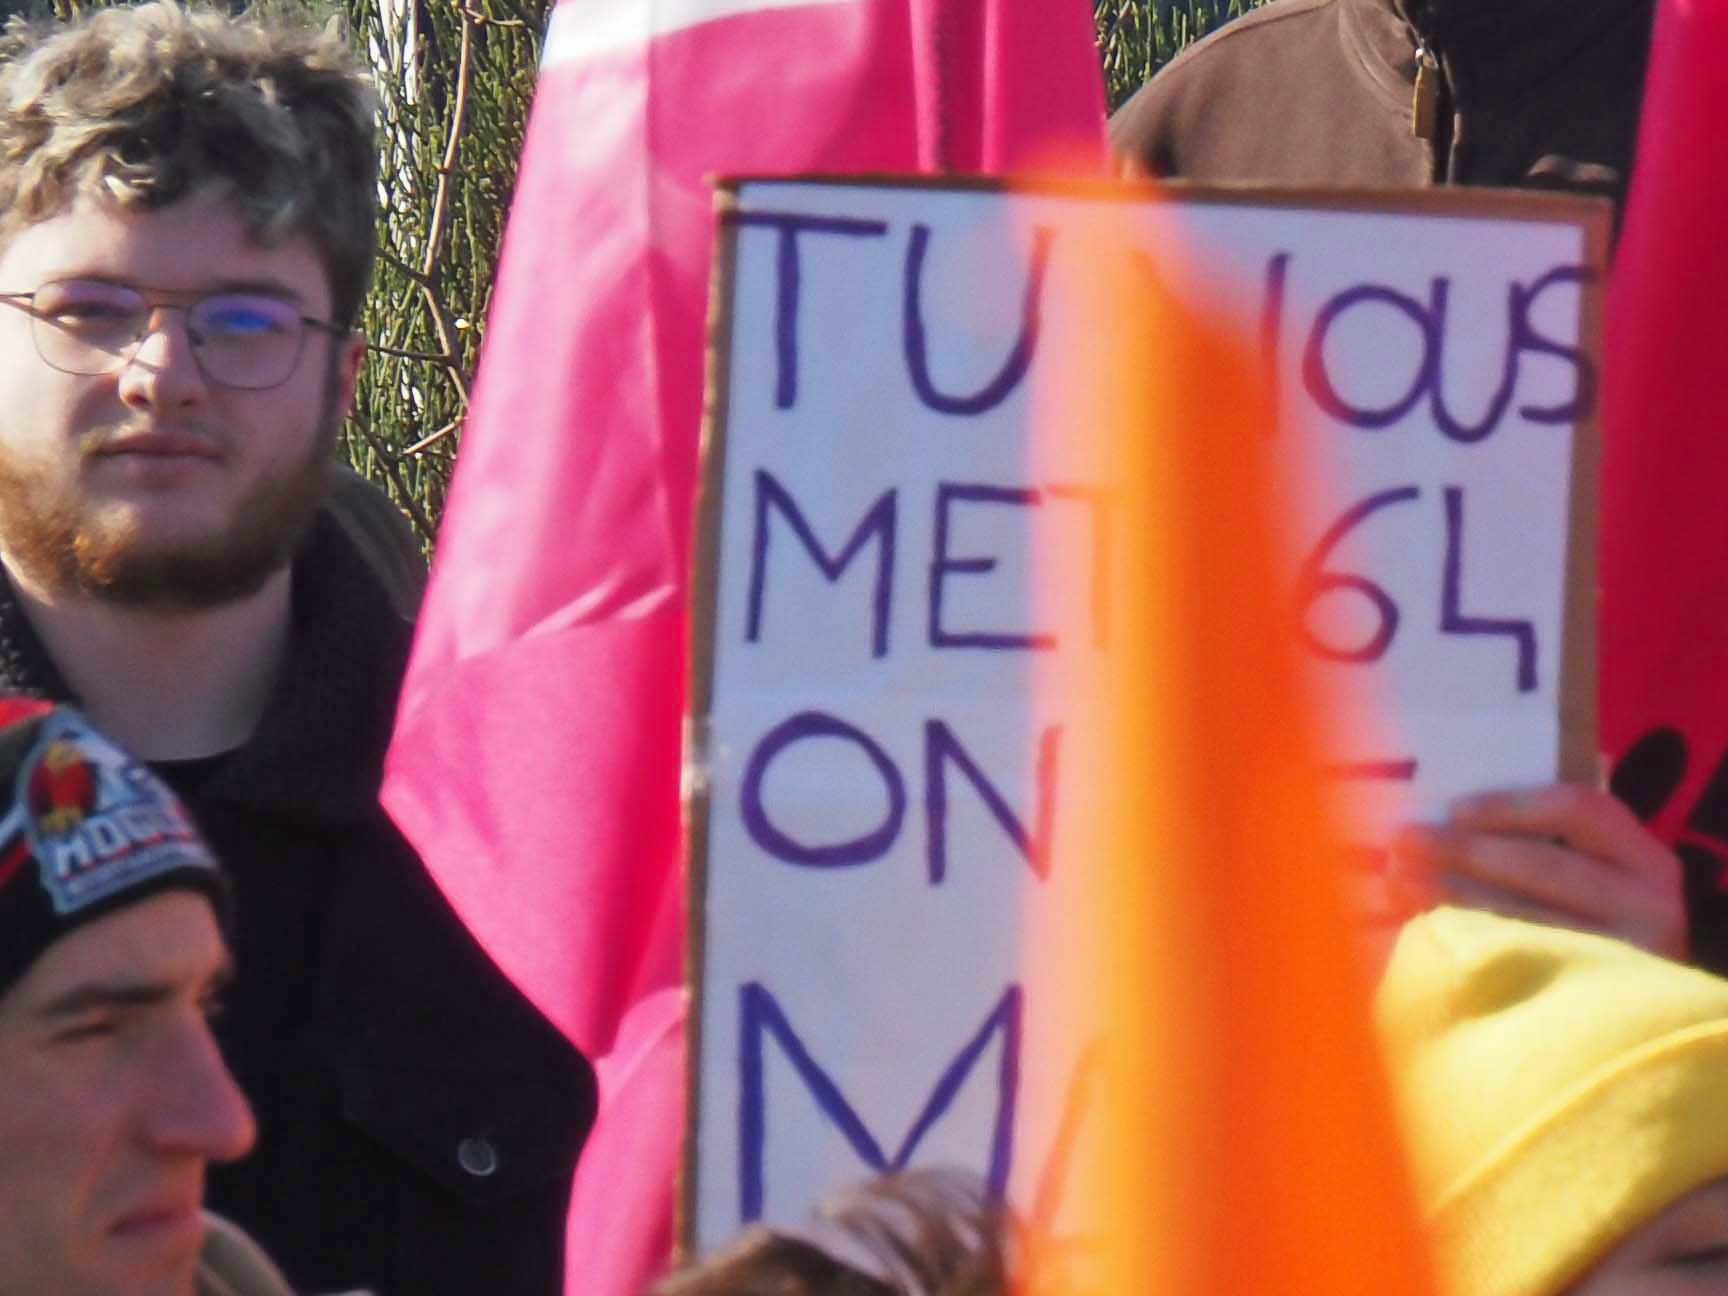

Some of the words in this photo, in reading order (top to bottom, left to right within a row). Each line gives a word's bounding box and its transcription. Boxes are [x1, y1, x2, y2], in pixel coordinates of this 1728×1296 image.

[718, 210, 1056, 417] TU
[1297, 484, 1538, 694] 64
[739, 710, 1063, 886] ON
